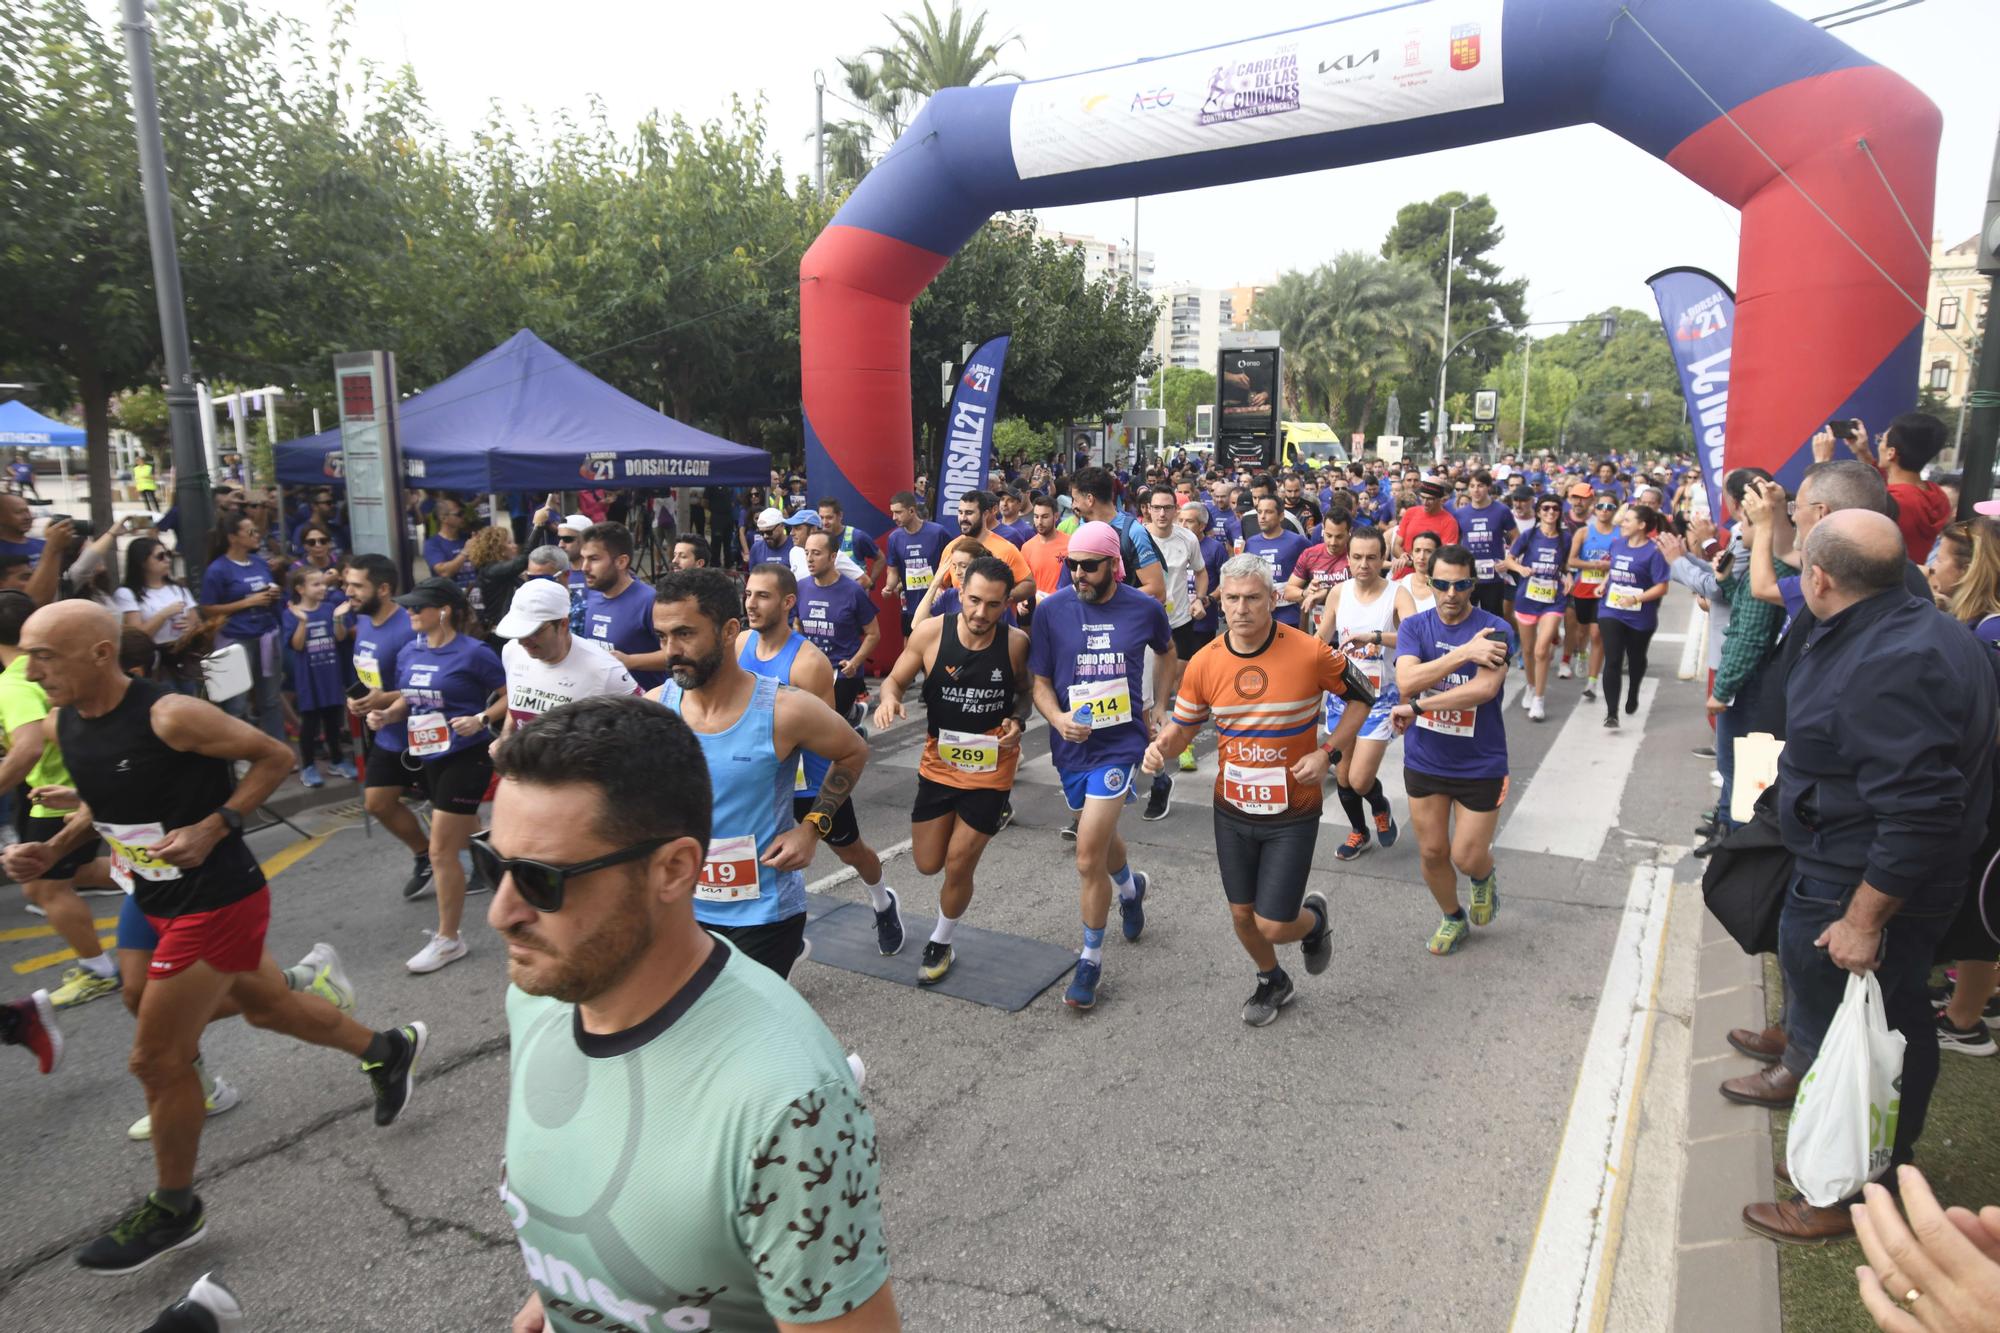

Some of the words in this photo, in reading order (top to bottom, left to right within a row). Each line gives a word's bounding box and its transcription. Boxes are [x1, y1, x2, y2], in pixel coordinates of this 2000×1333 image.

[1236, 54, 1297, 77] CARRERA
[1318, 49, 1380, 74] KIA
[1255, 72, 1271, 88] DE
[1274, 67, 1298, 85] LAS
[1131, 87, 1175, 113] AEG
[1233, 83, 1300, 109] CIUDADES
[1695, 304, 1728, 338] 21
[973, 372, 991, 392] 21
[593, 460, 614, 480] 21
[625, 459, 710, 476] DORSAL21.COM
[1099, 652, 1116, 664] POR
[1098, 664, 1114, 675] POR
[534, 689, 573, 703] TRIATLON
[942, 686, 1005, 698] VALENCIA
[962, 701, 1004, 713] FASTER
[951, 748, 984, 762] 269
[1239, 742, 1288, 762] bitec
[1236, 784, 1271, 801] 118
[702, 863, 736, 883] 19
